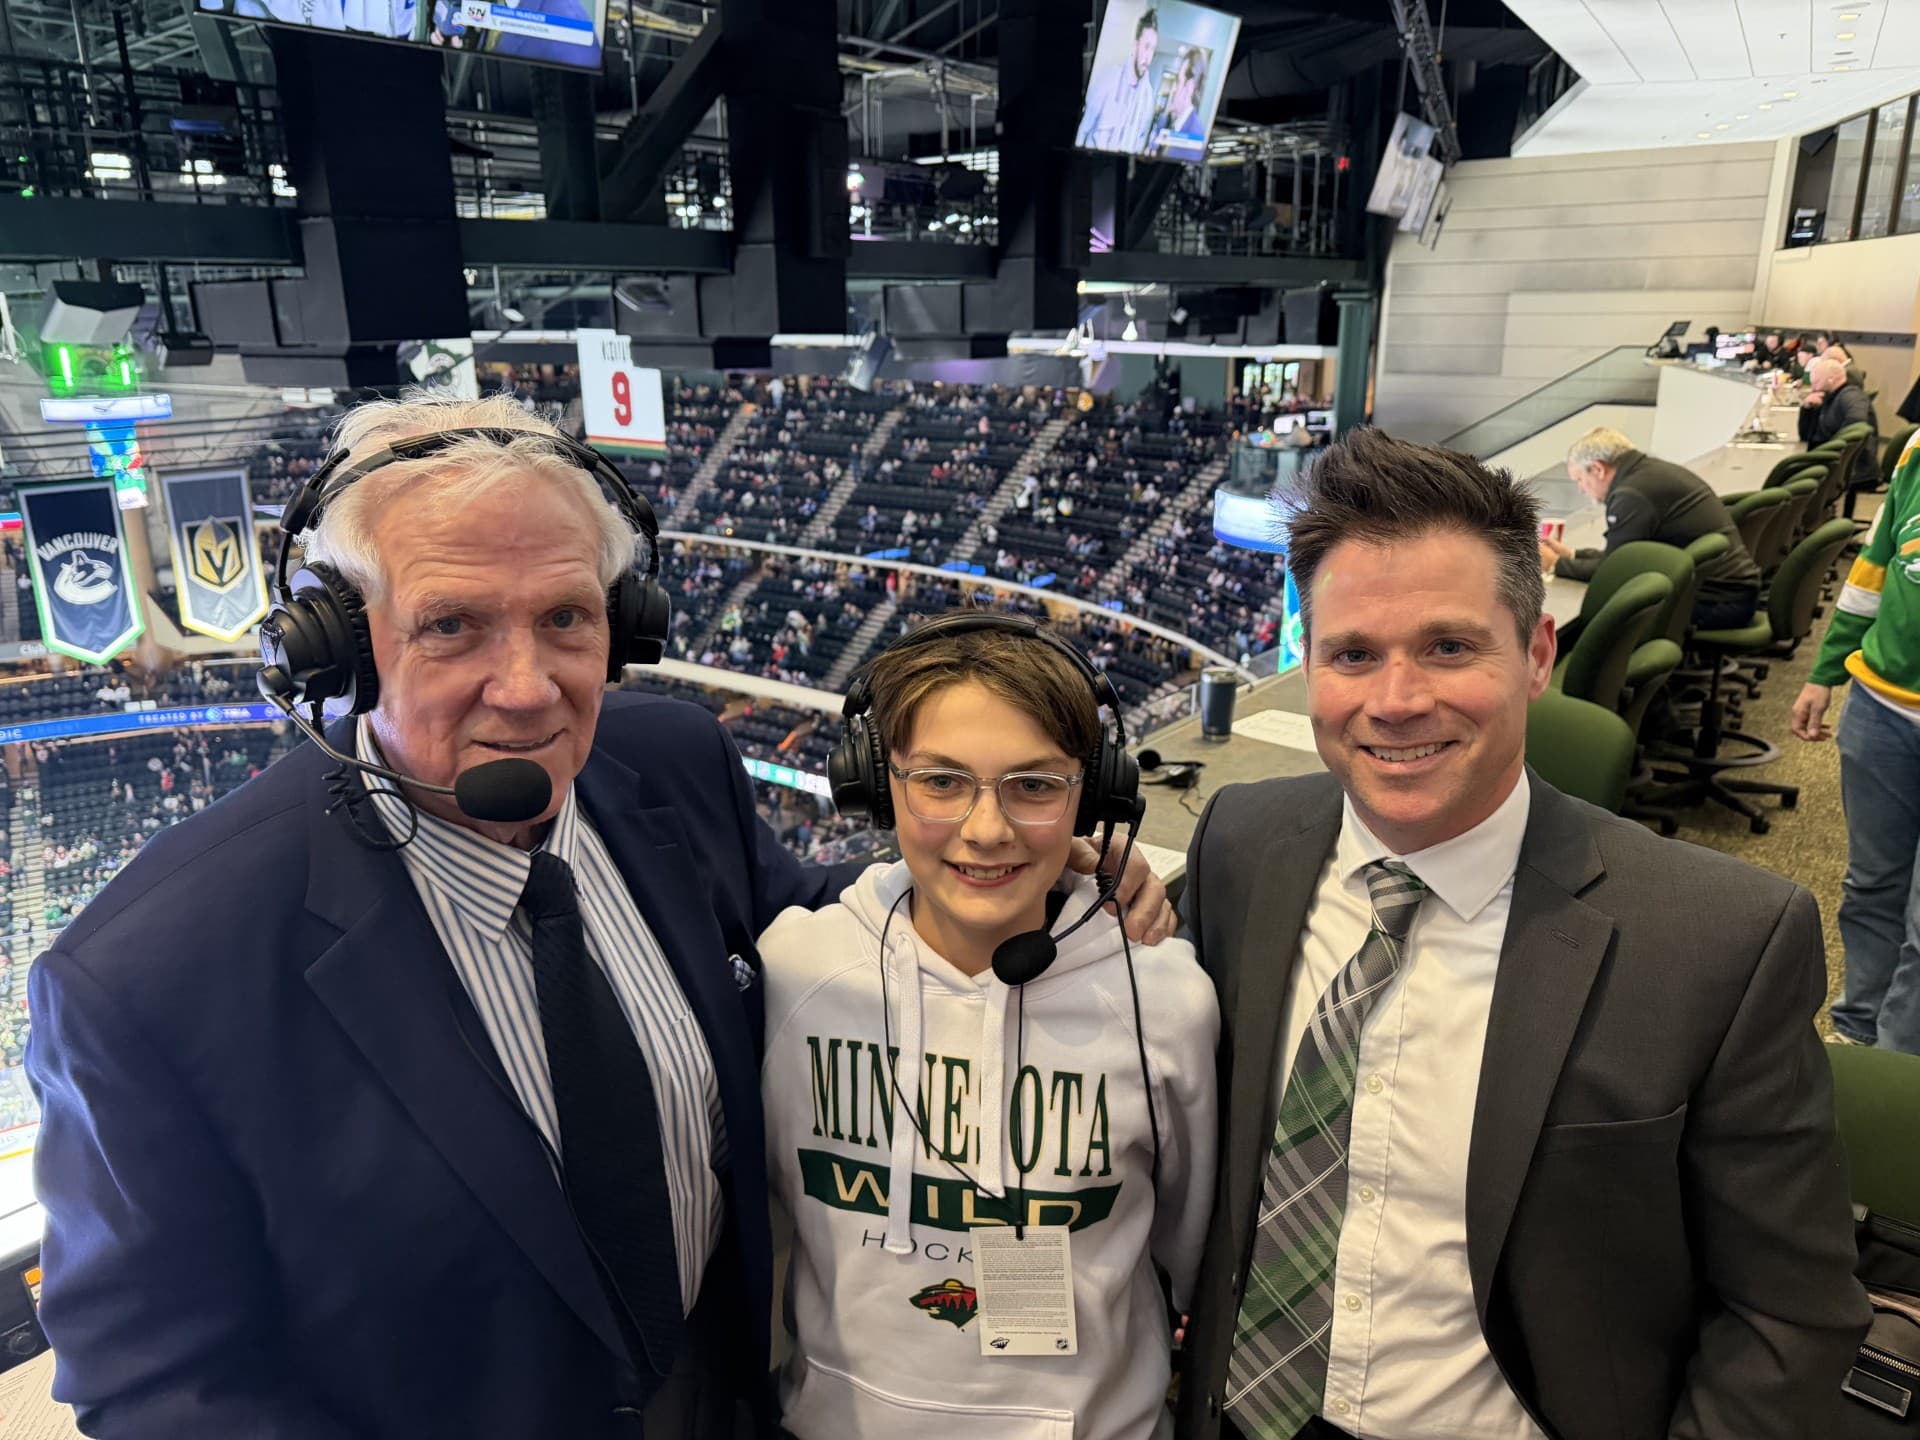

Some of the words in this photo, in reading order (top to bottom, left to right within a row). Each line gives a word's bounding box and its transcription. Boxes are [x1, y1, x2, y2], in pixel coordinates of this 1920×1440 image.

[467, 6, 486, 18] SN
[612, 371, 632, 427] 9
[37, 532, 119, 562] VANCOUVER
[807, 1036, 1112, 1177] MINNEOTA
